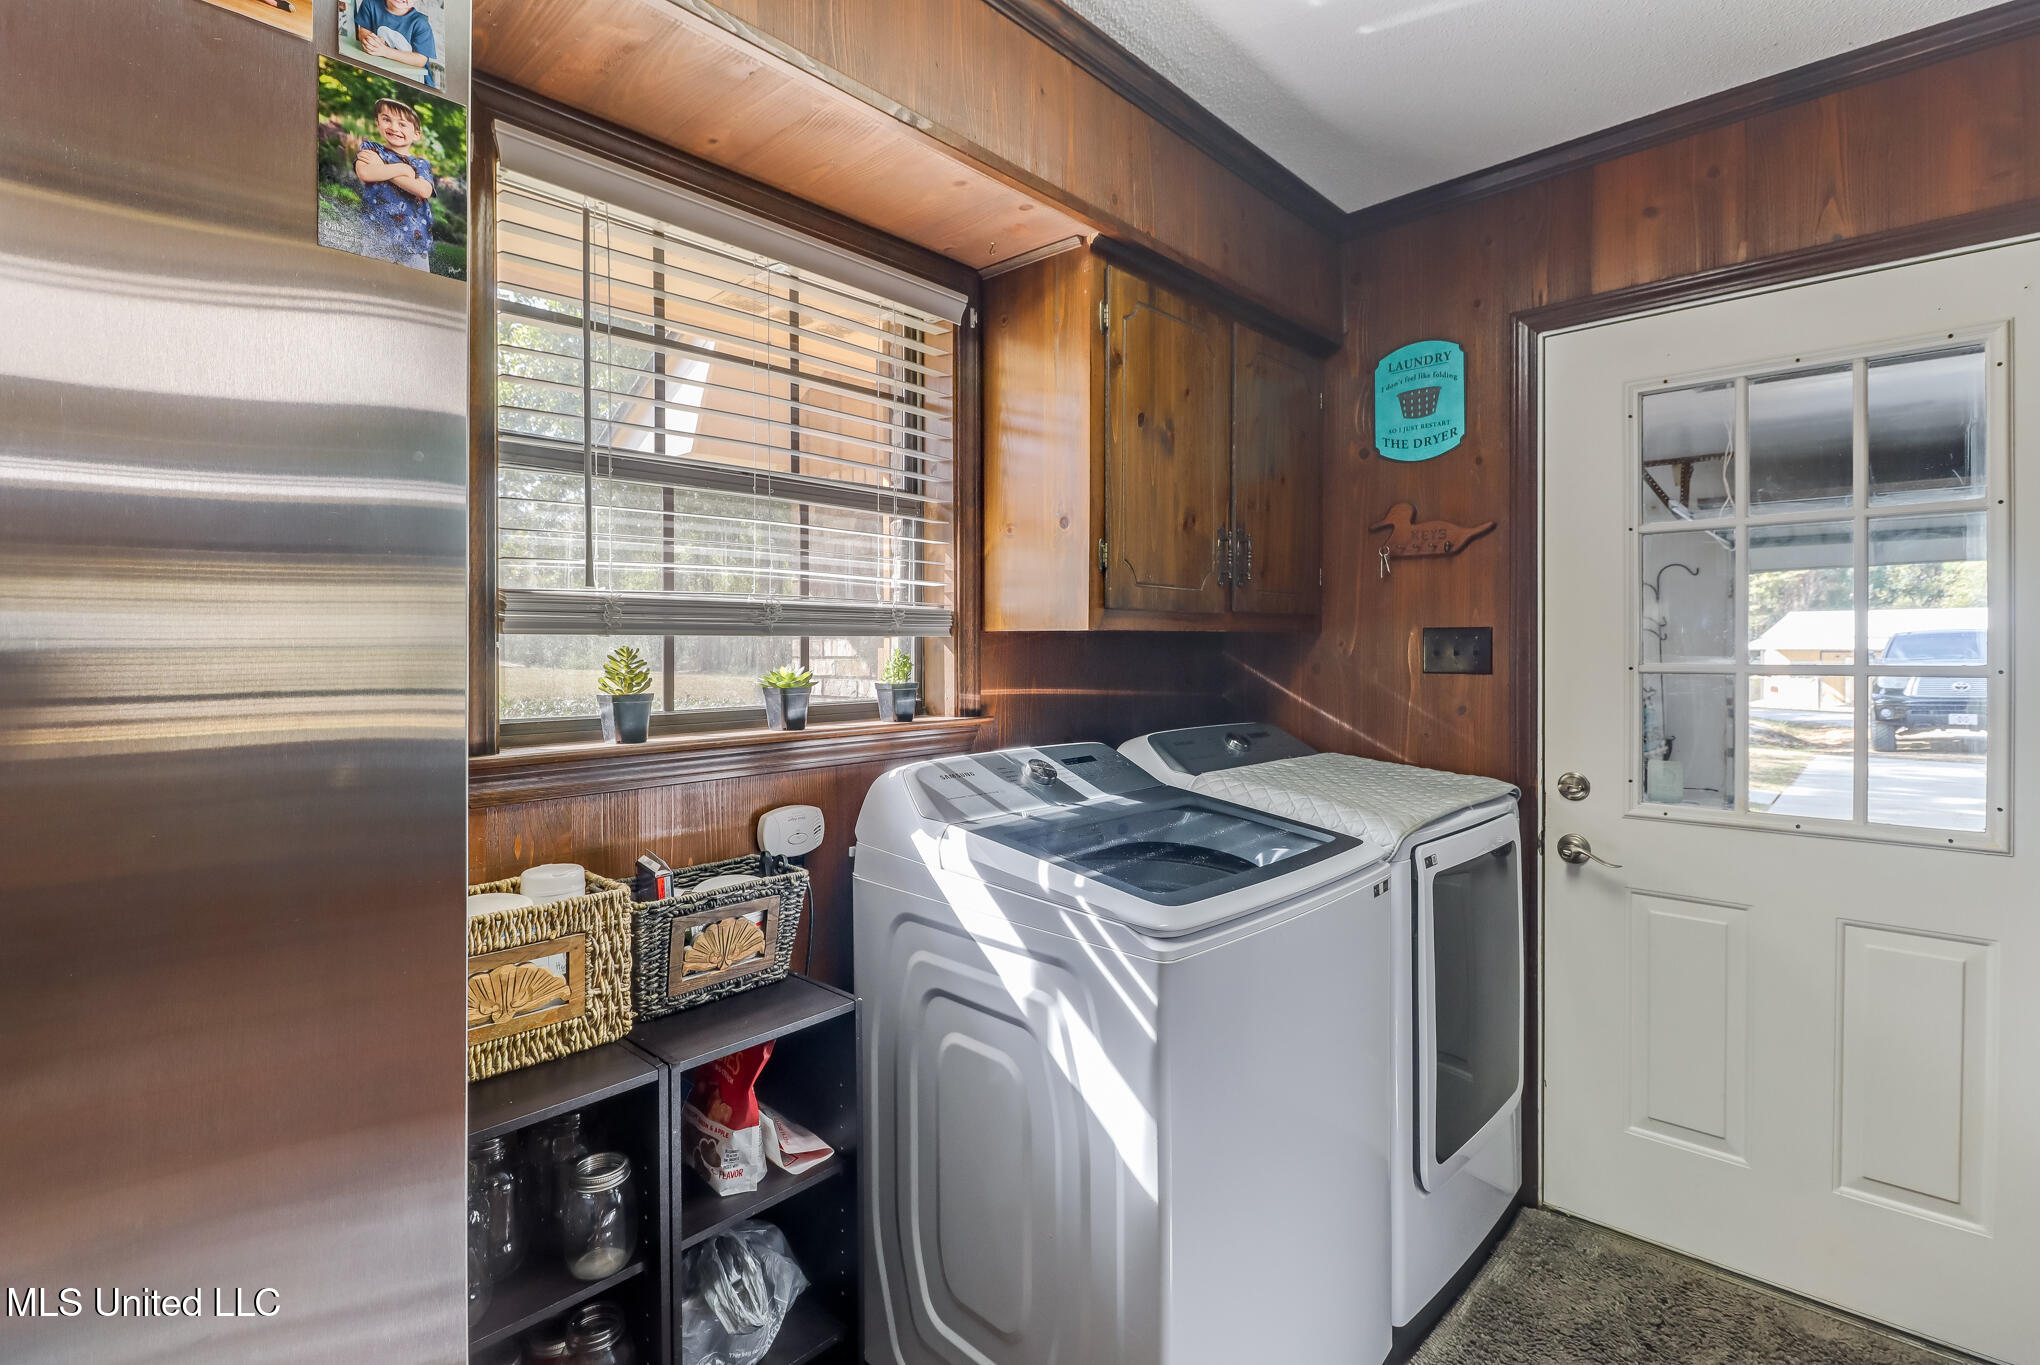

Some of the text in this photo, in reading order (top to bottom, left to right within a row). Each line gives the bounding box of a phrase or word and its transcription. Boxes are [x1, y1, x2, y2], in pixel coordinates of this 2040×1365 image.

[1388, 350, 1452, 373] LAUNDRY
[1385, 379, 1403, 391] don't
[1404, 374, 1417, 383] feel
[1418, 372, 1431, 380] like
[1432, 371, 1458, 381] folding
[1403, 424, 1419, 434] JUST
[1420, 419, 1450, 429] RESTART
[1382, 427, 1458, 449] THE DRYER
[1410, 528, 1448, 542] KEYS
[939, 771, 975, 780] SAMSUNG
[718, 1168, 744, 1180] FLAVOR
